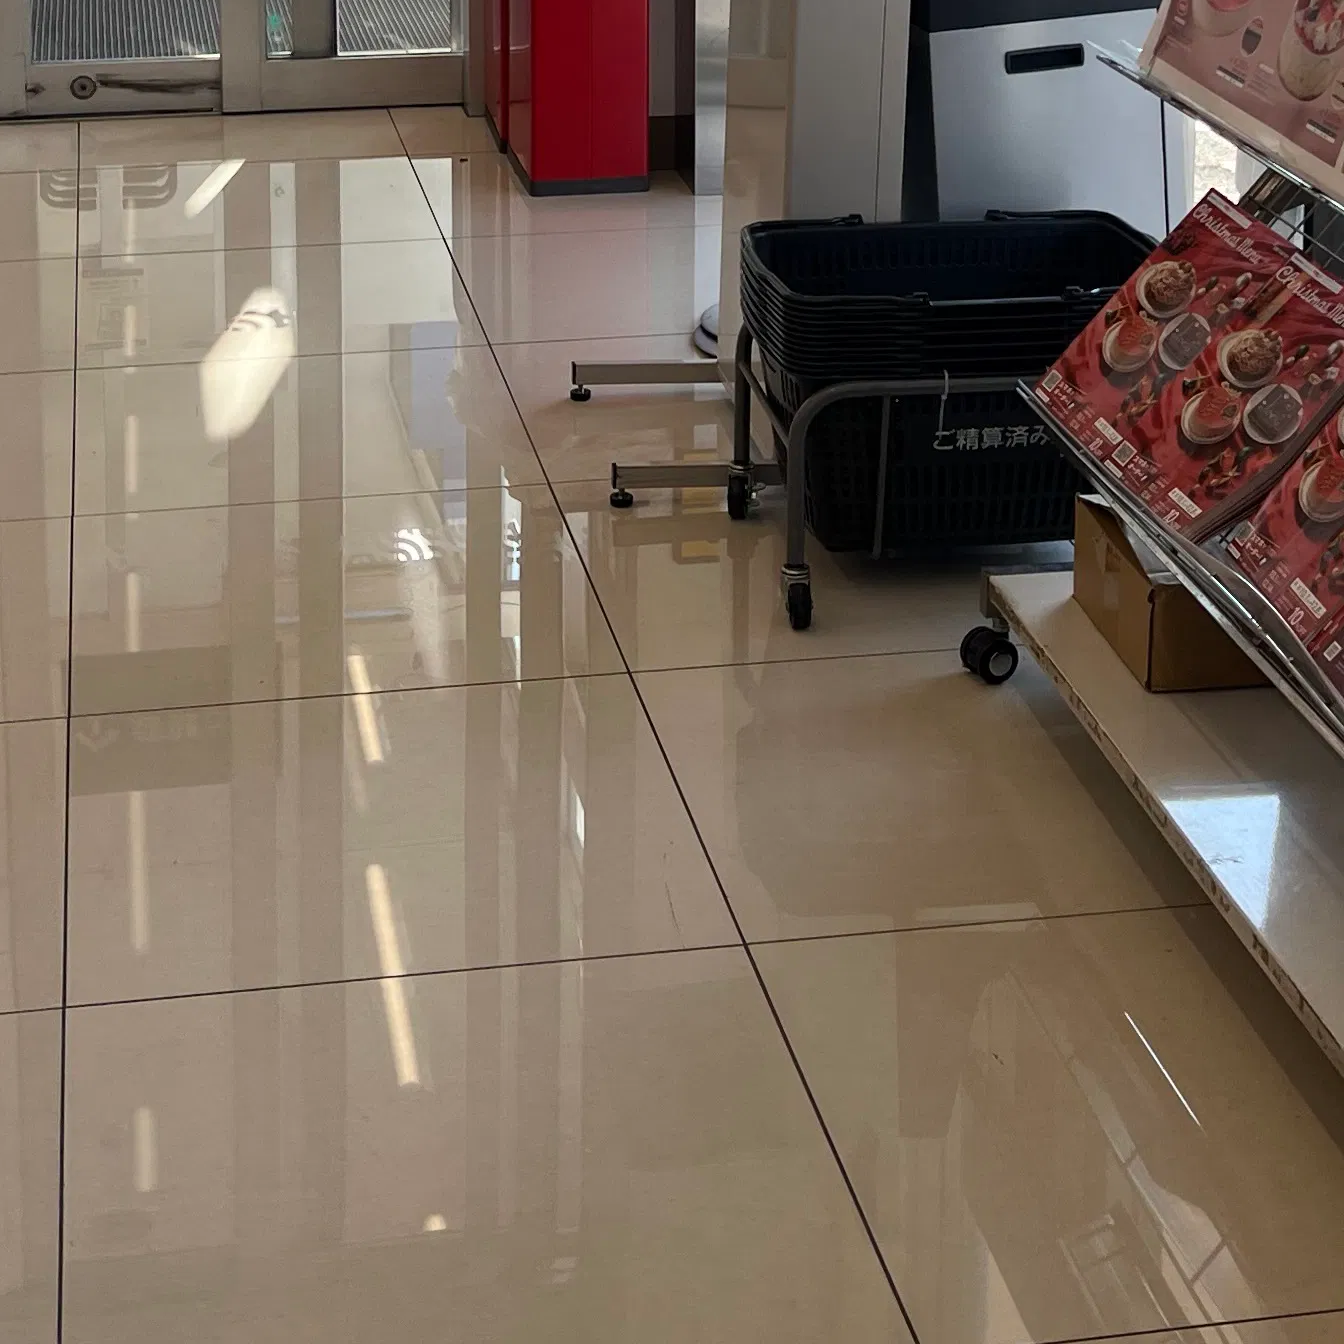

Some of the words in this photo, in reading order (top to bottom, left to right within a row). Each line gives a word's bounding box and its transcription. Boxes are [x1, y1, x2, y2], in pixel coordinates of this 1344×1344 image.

[932, 424, 1052, 452] ご精算済み
